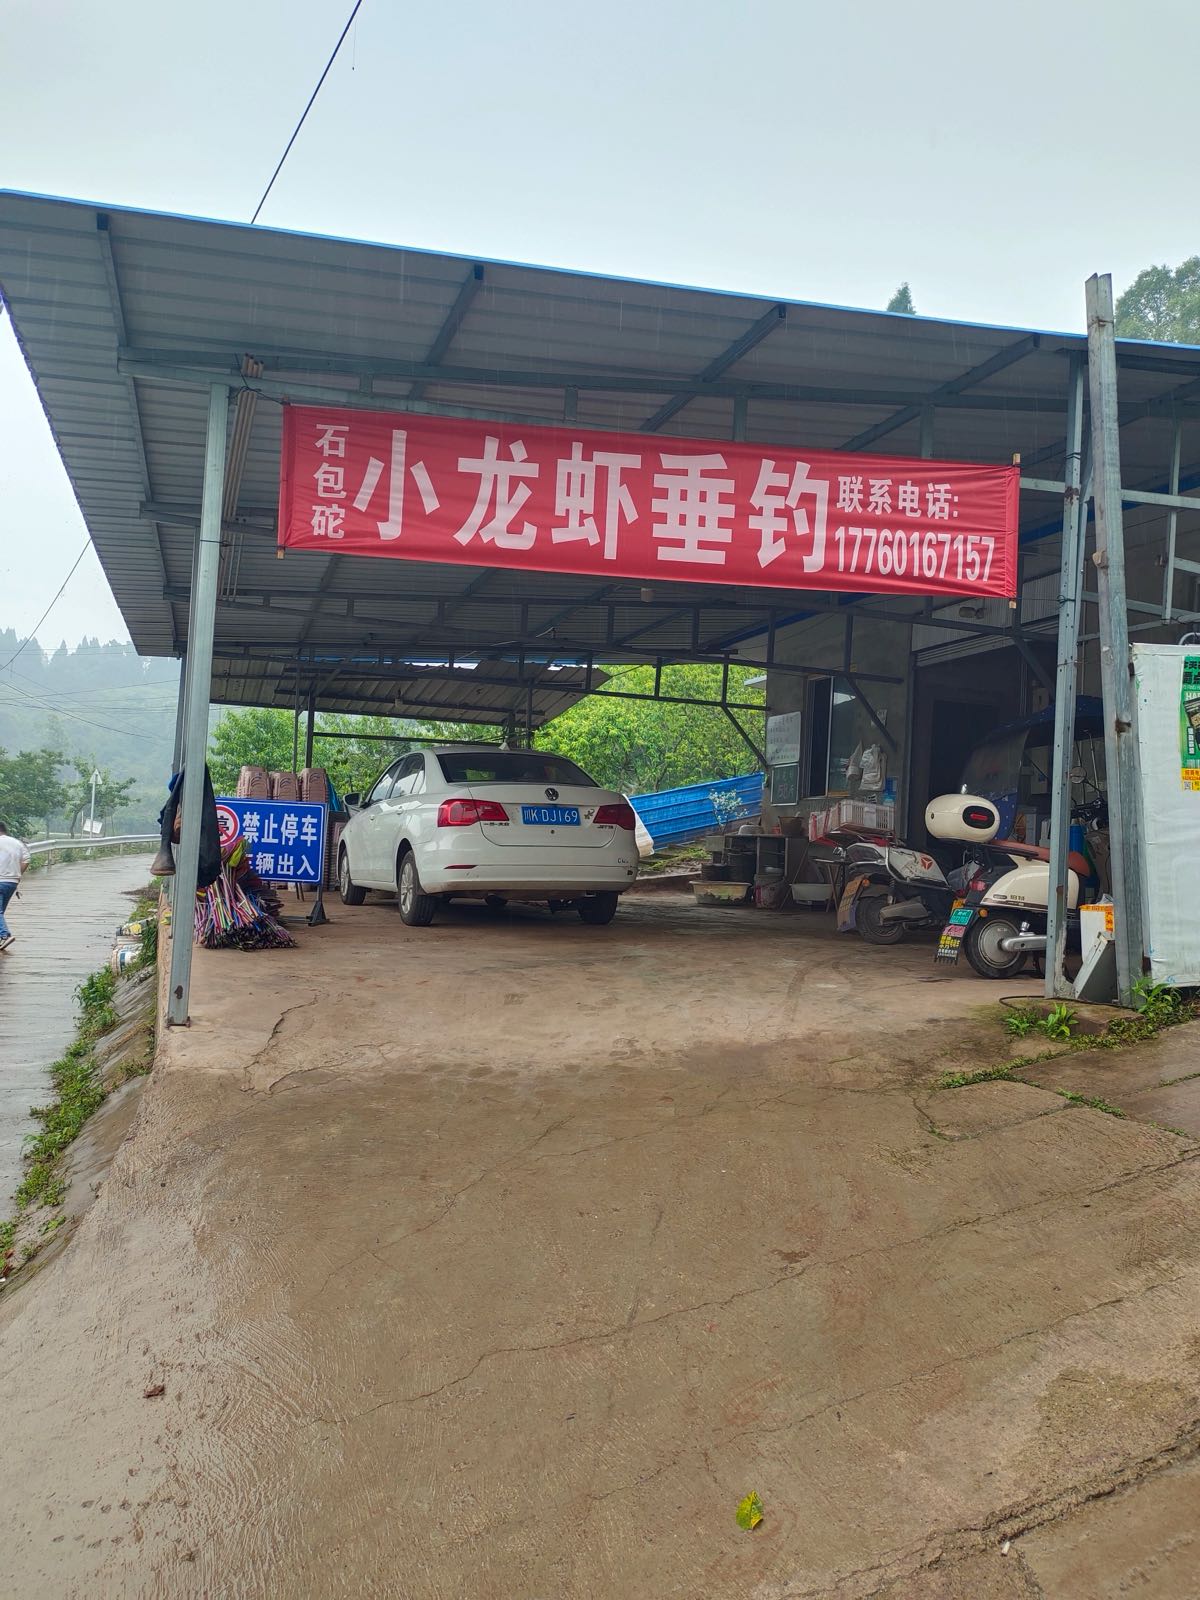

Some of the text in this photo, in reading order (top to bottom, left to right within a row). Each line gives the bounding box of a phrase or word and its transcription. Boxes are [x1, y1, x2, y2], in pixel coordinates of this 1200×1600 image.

[310, 423, 350, 540] 石包砣
[352, 428, 830, 573] 小龙虾垂钓
[834, 525, 996, 583] 17760167157
[242, 811, 318, 847] 禁止停车
